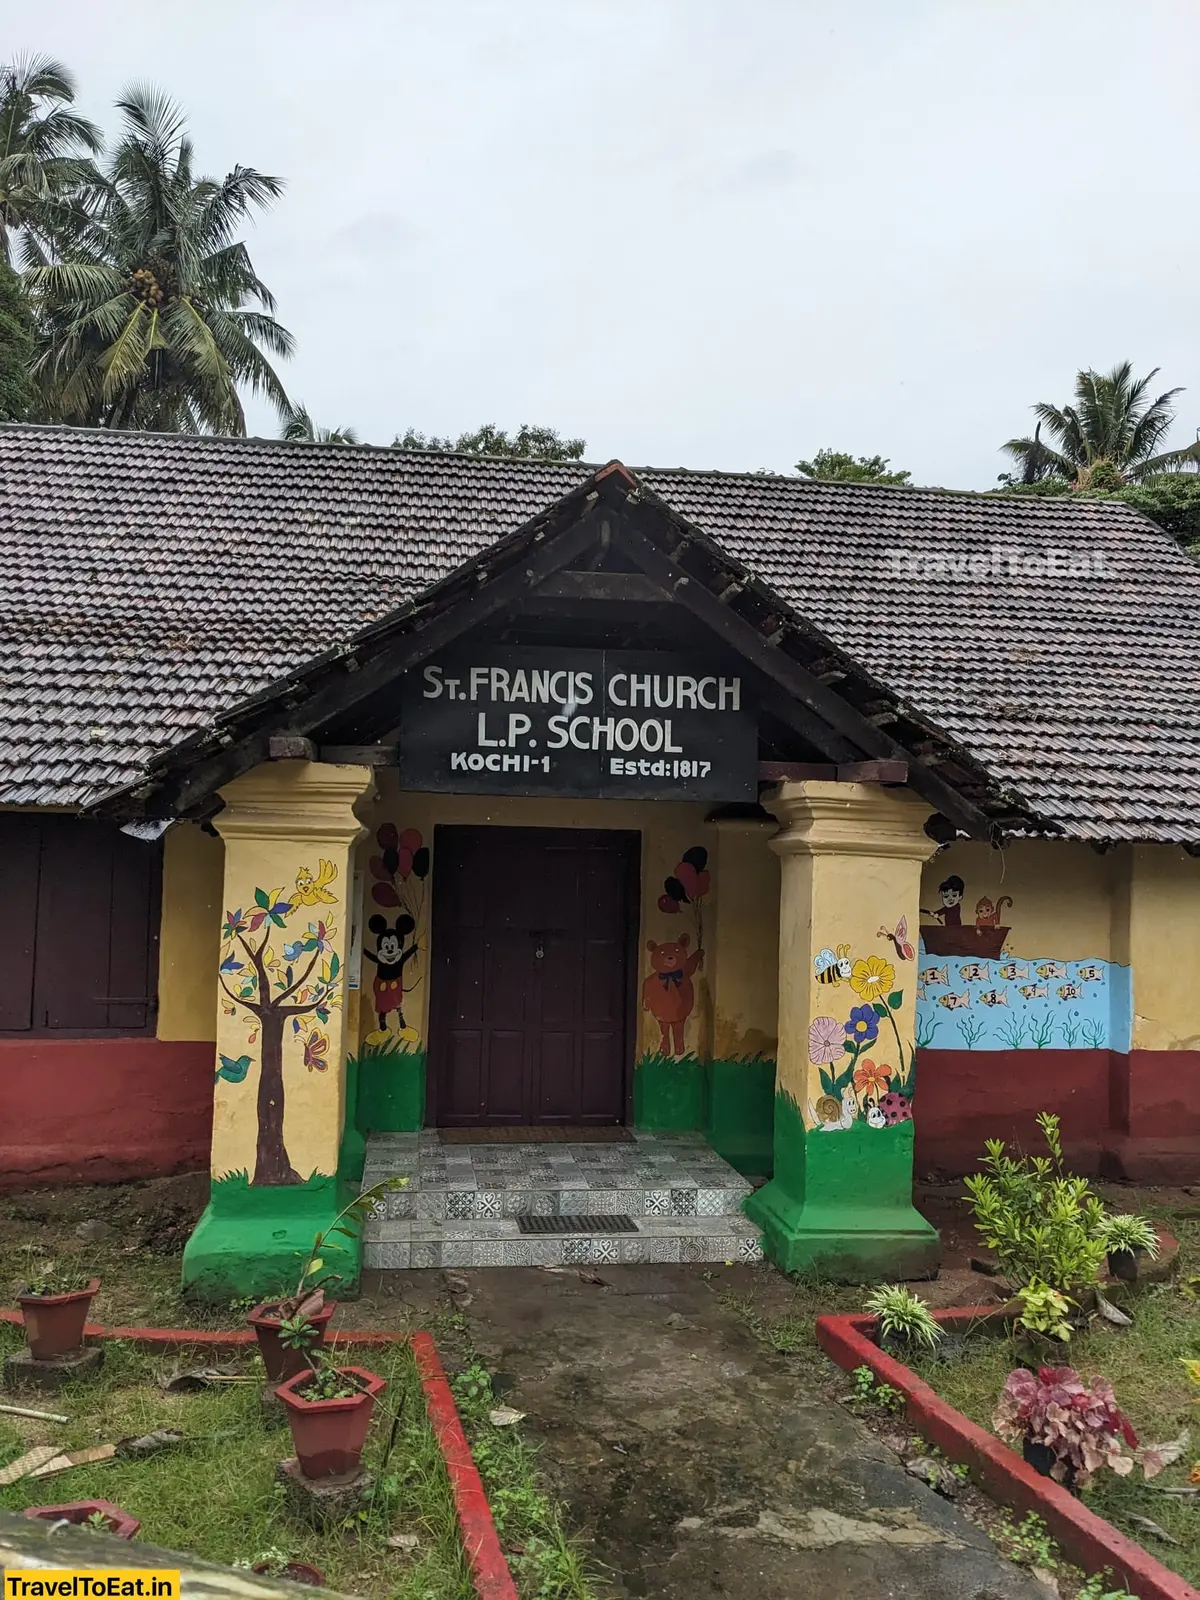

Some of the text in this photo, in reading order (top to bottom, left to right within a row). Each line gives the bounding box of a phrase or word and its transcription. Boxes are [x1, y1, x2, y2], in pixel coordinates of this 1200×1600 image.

[608, 673, 741, 711] CHURCH
[477, 712, 683, 754] L.P. SCHOOL
[451, 752, 550, 773] KOCHI-1
[929, 967, 1095, 980] 1 2 3 4 5
[950, 987, 1076, 1005] 7 8 9 10
